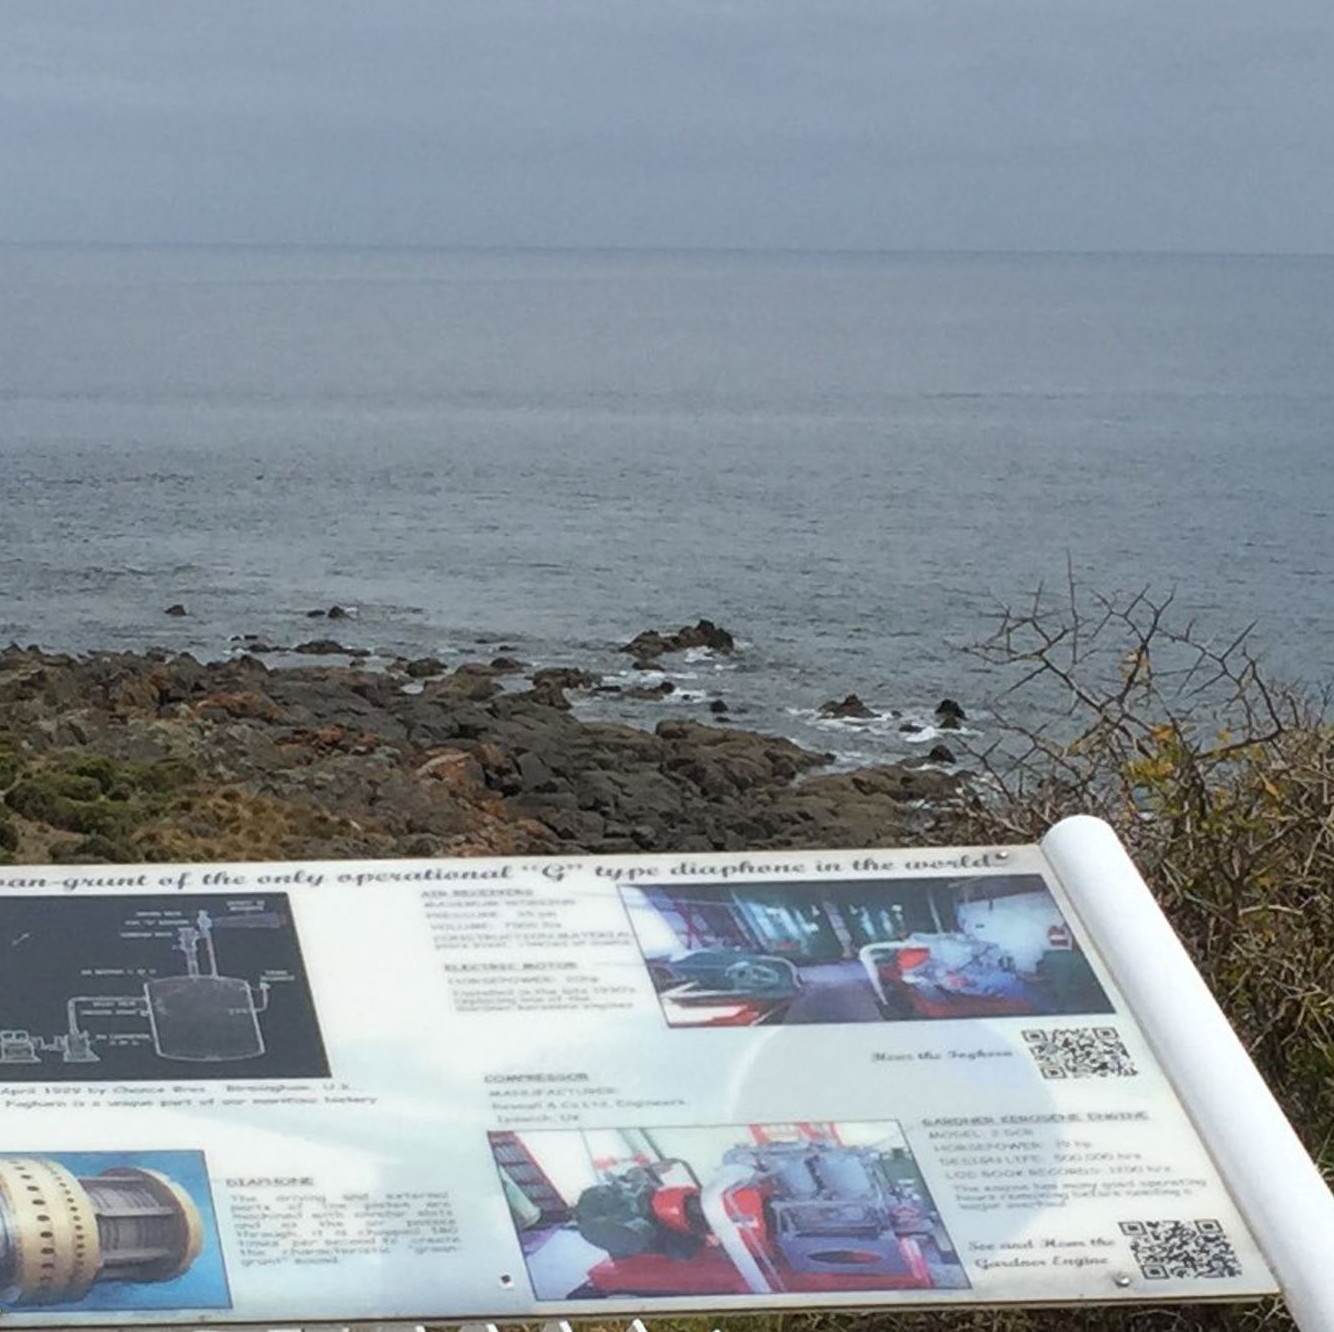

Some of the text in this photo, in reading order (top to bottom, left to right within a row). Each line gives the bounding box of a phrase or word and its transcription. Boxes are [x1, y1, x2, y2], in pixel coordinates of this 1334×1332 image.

[158, 871, 192, 890] of
[202, 871, 247, 886] the
[257, 867, 325, 887] only
[337, 866, 515, 886] operational
[595, 864, 660, 880] type
[670, 860, 806, 878] diaphone
[816, 860, 842, 872] in
[852, 857, 895, 872] the
[1052, 1254, 1110, 1268] Engine
